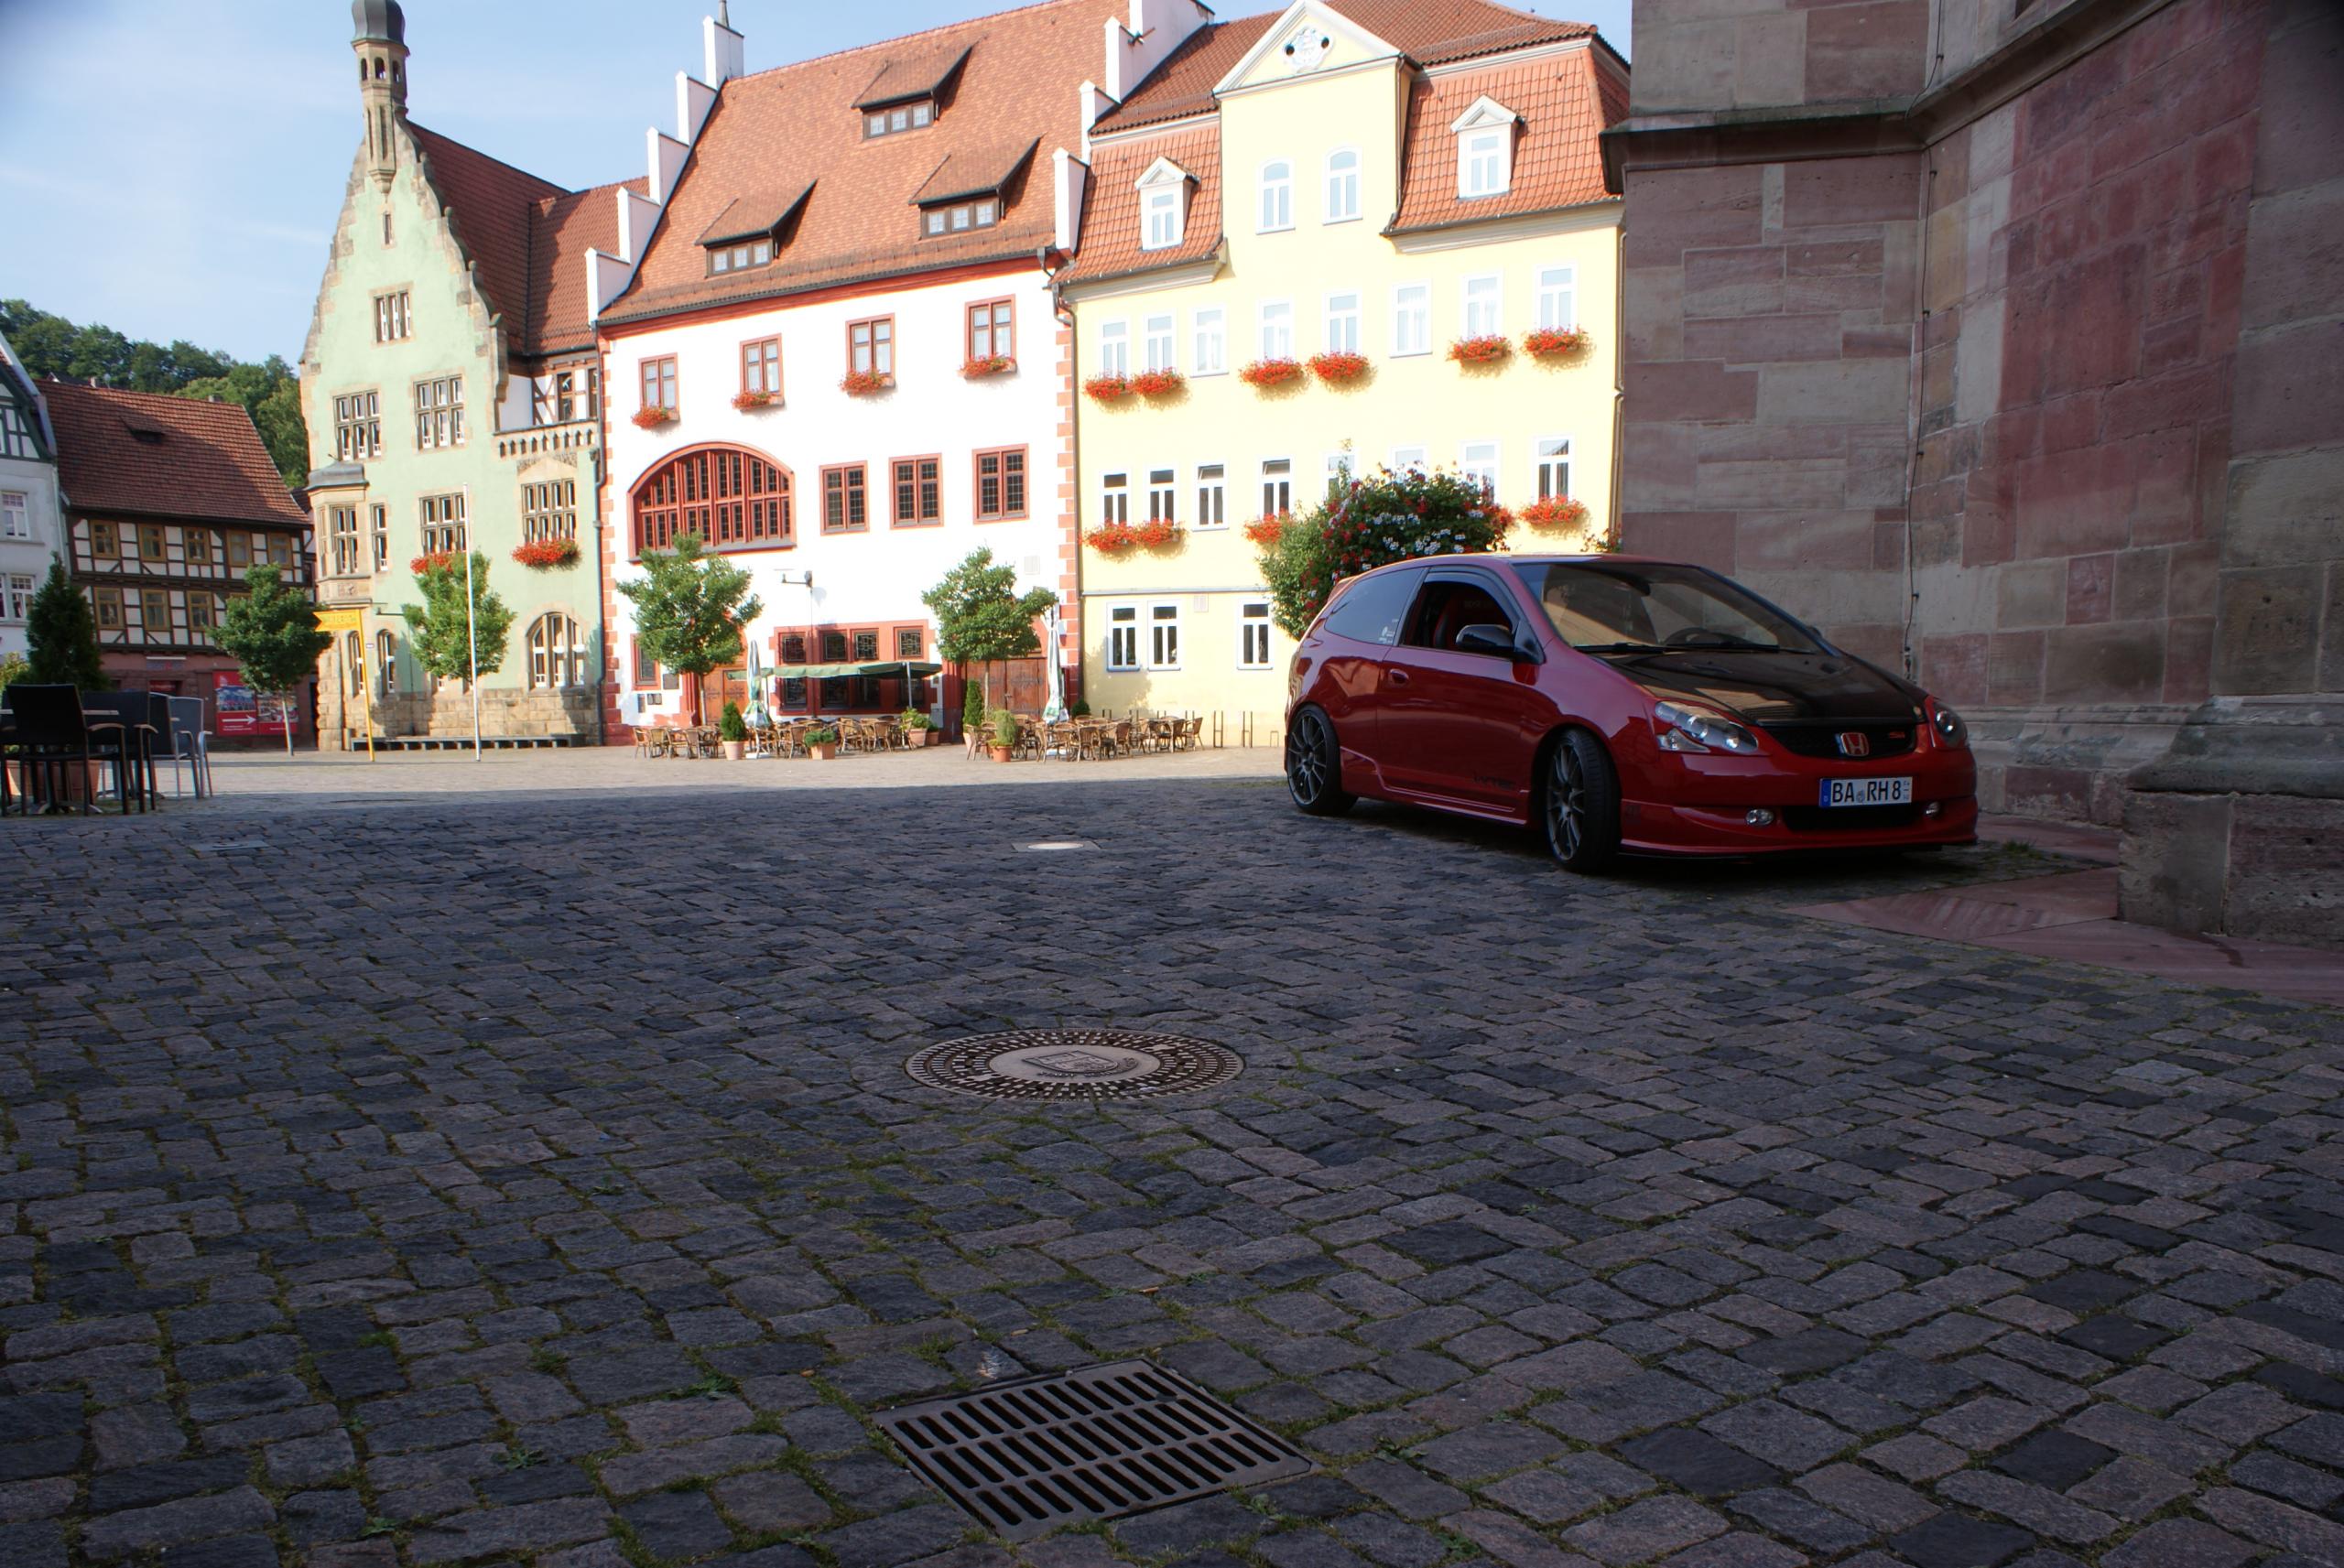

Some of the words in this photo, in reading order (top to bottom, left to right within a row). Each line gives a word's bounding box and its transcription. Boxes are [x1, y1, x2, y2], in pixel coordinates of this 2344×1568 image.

[1832, 782, 1855, 803] BA
[1867, 781, 1889, 801] RH
[1892, 780, 1901, 800] 8
